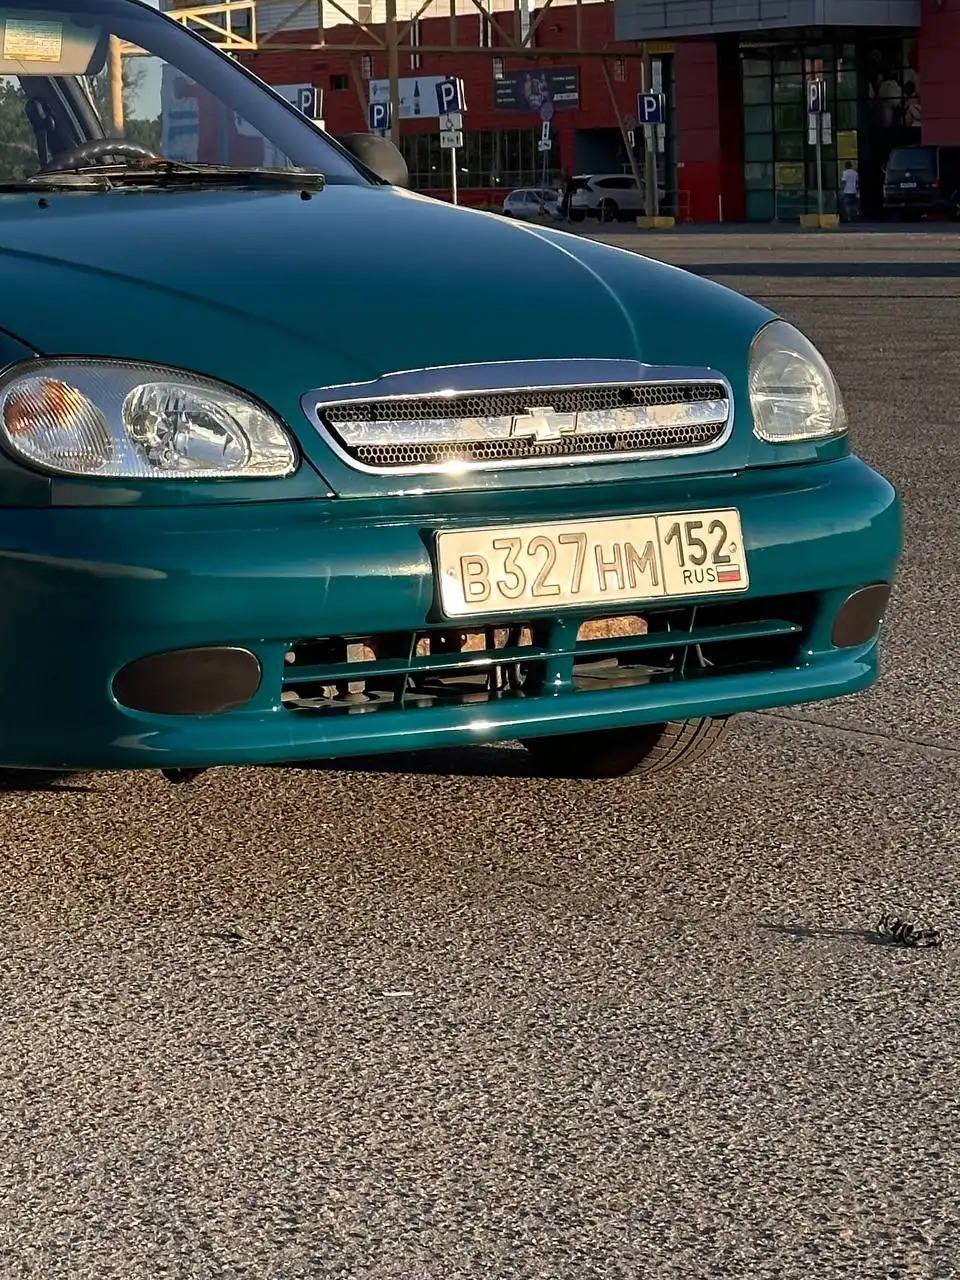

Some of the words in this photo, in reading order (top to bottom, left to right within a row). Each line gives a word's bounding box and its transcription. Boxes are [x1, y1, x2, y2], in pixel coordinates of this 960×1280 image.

[302, 91, 312, 115] P
[441, 83, 455, 111] P
[644, 96, 657, 121] P
[810, 84, 818, 111] P
[373, 105, 385, 127] P
[664, 519, 731, 568] 152
[460, 532, 658, 603] В327НМ
[683, 568, 716, 585] RUS
